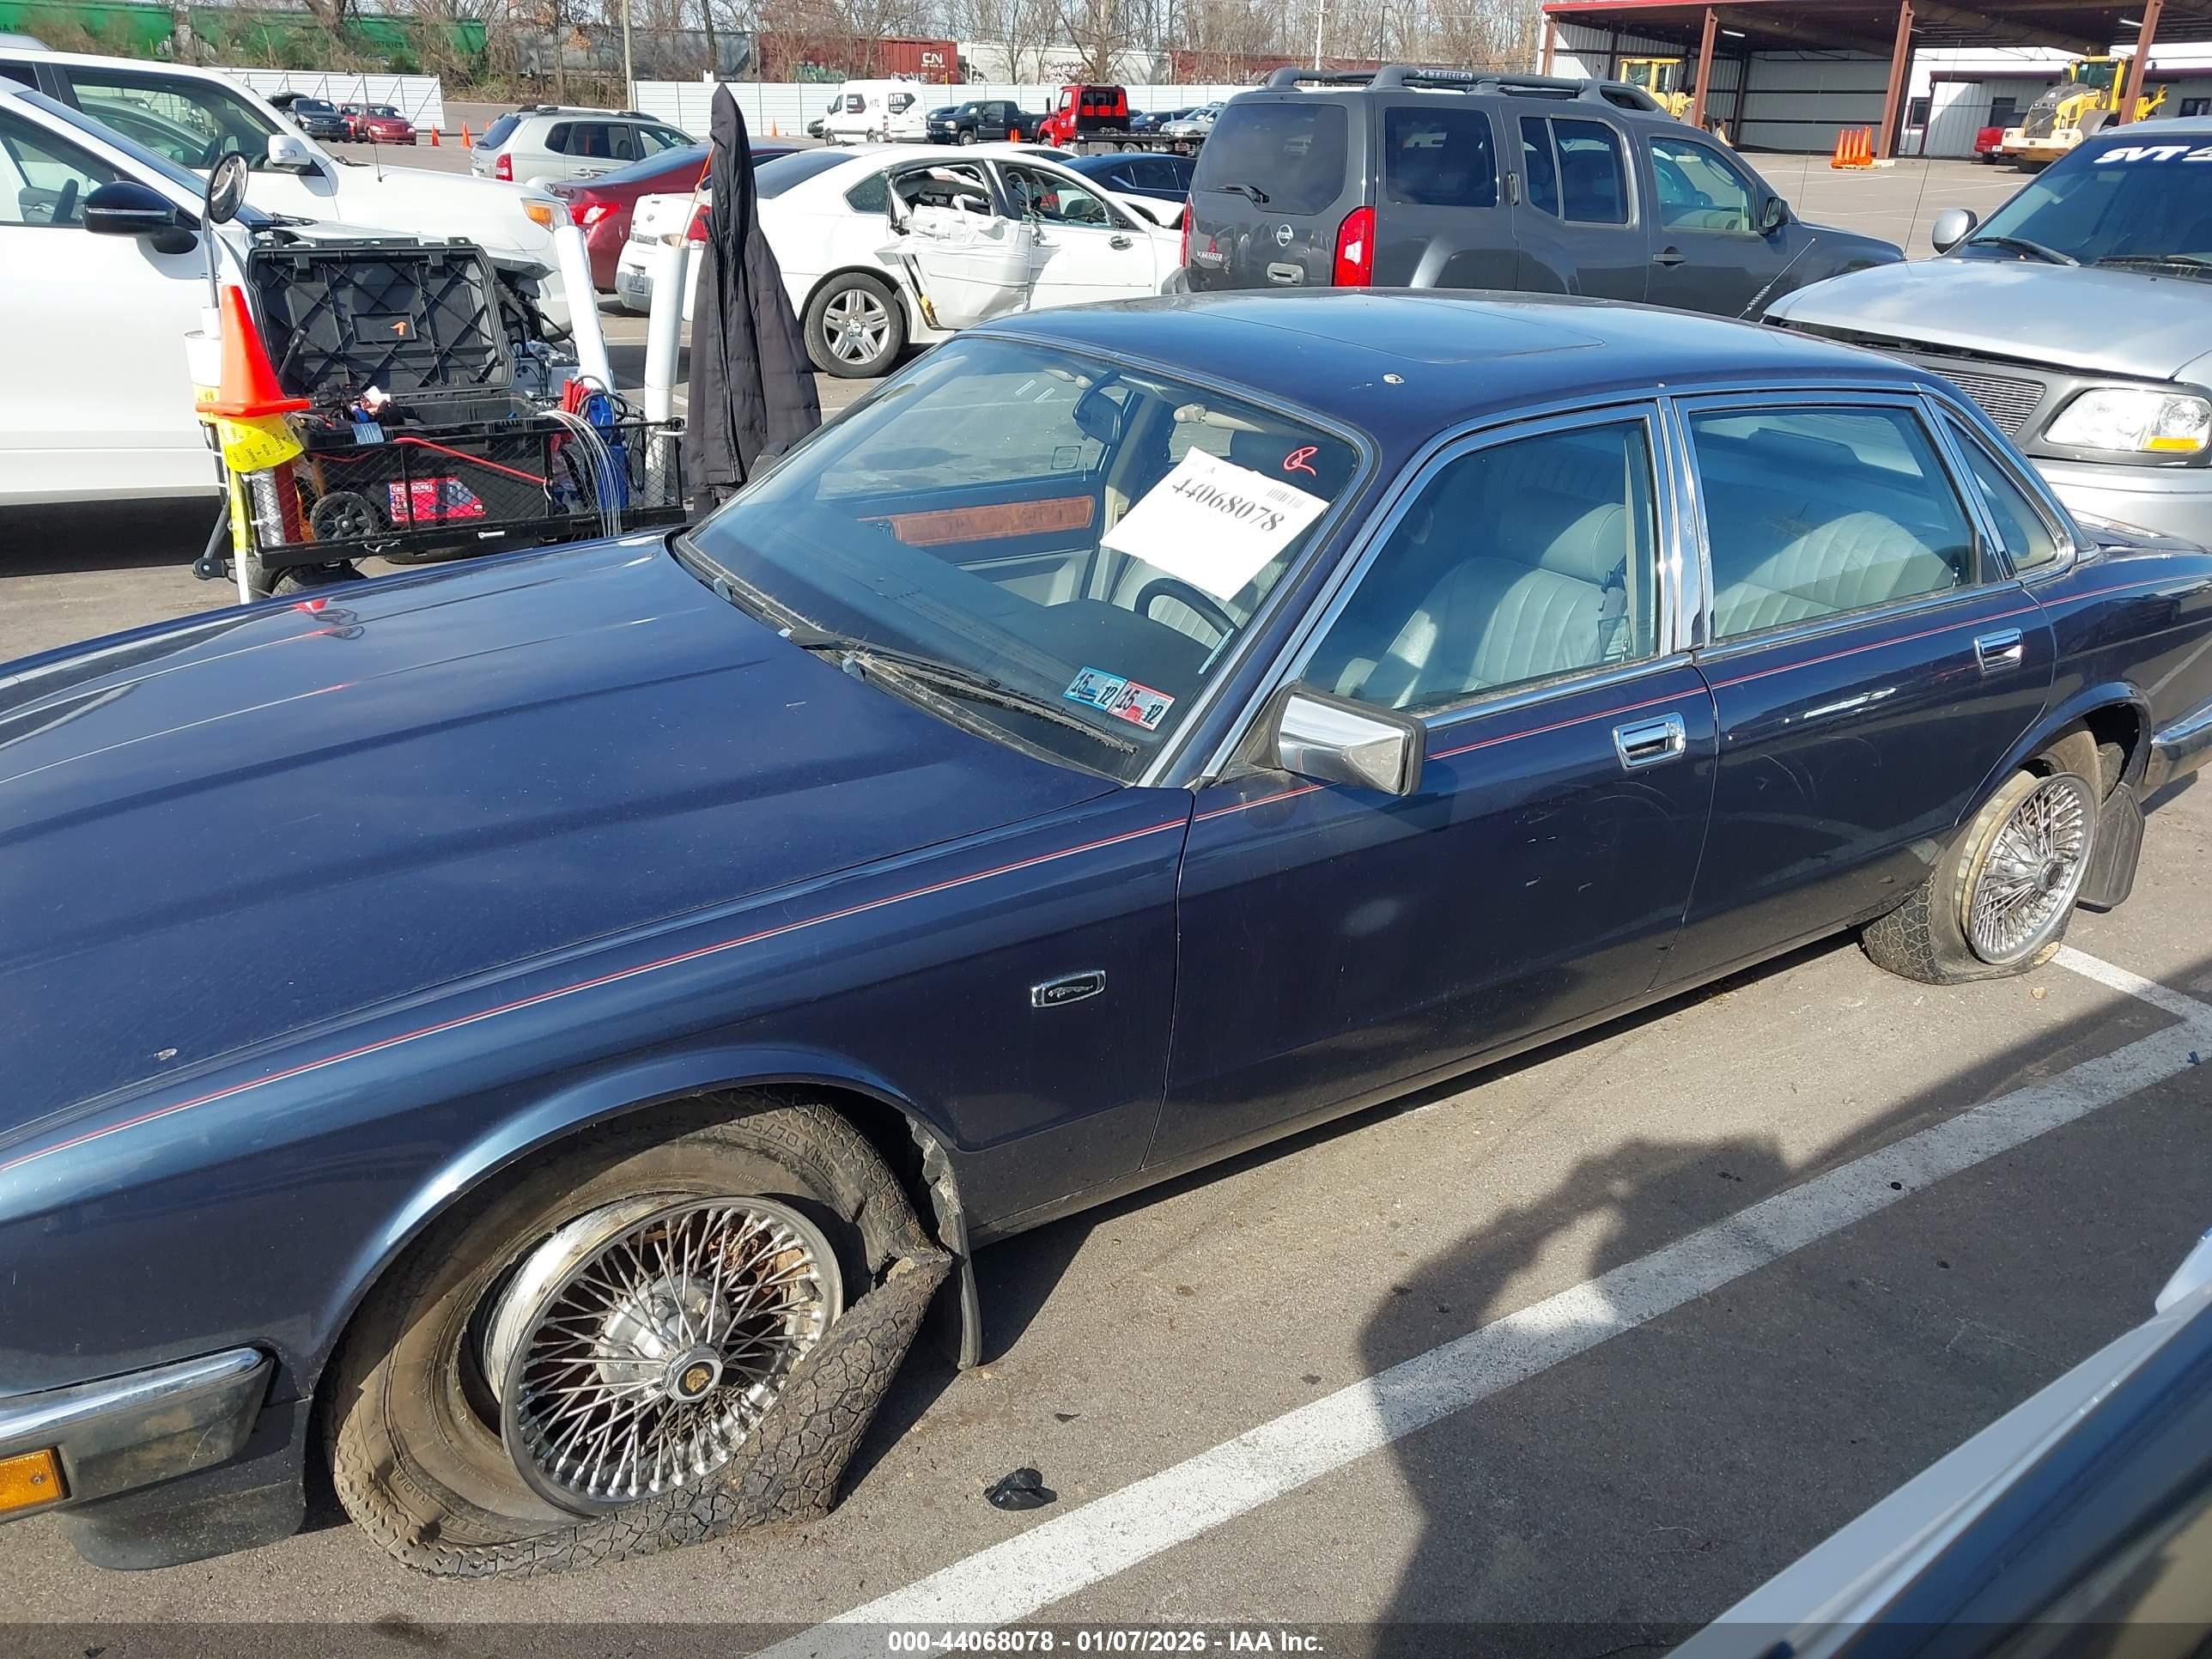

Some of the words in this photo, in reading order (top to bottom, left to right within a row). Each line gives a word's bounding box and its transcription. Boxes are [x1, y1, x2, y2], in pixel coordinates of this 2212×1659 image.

[922, 52, 944, 64] CN
[2094, 145, 2192, 164] SVT
[261, 442, 271, 457] RUN
[1172, 477, 1285, 532] 44068078
[1071, 672, 1095, 694] 15
[1097, 684, 1119, 707] 12
[1115, 687, 1141, 711] 15
[1140, 702, 1164, 725] 12
[725, 1117, 799, 1148] 05/70
